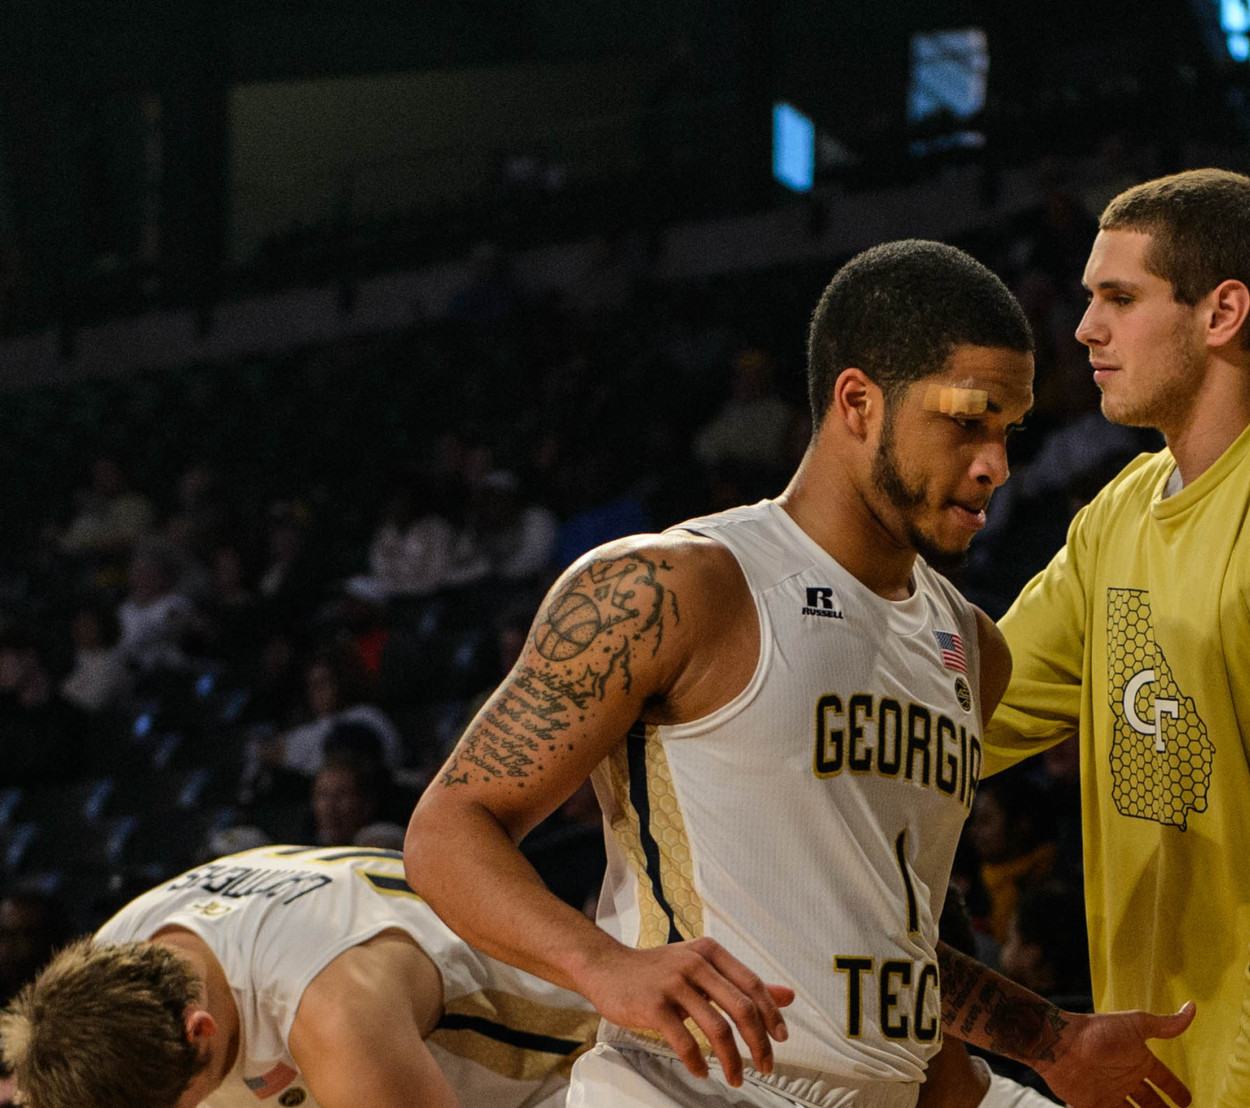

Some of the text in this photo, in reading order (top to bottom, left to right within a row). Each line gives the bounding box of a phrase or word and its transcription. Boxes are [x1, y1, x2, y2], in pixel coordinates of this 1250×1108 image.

[802, 606, 844, 619] RUSSELL
[814, 693, 982, 808] GEORGIA
[834, 955, 943, 1045] TEC
